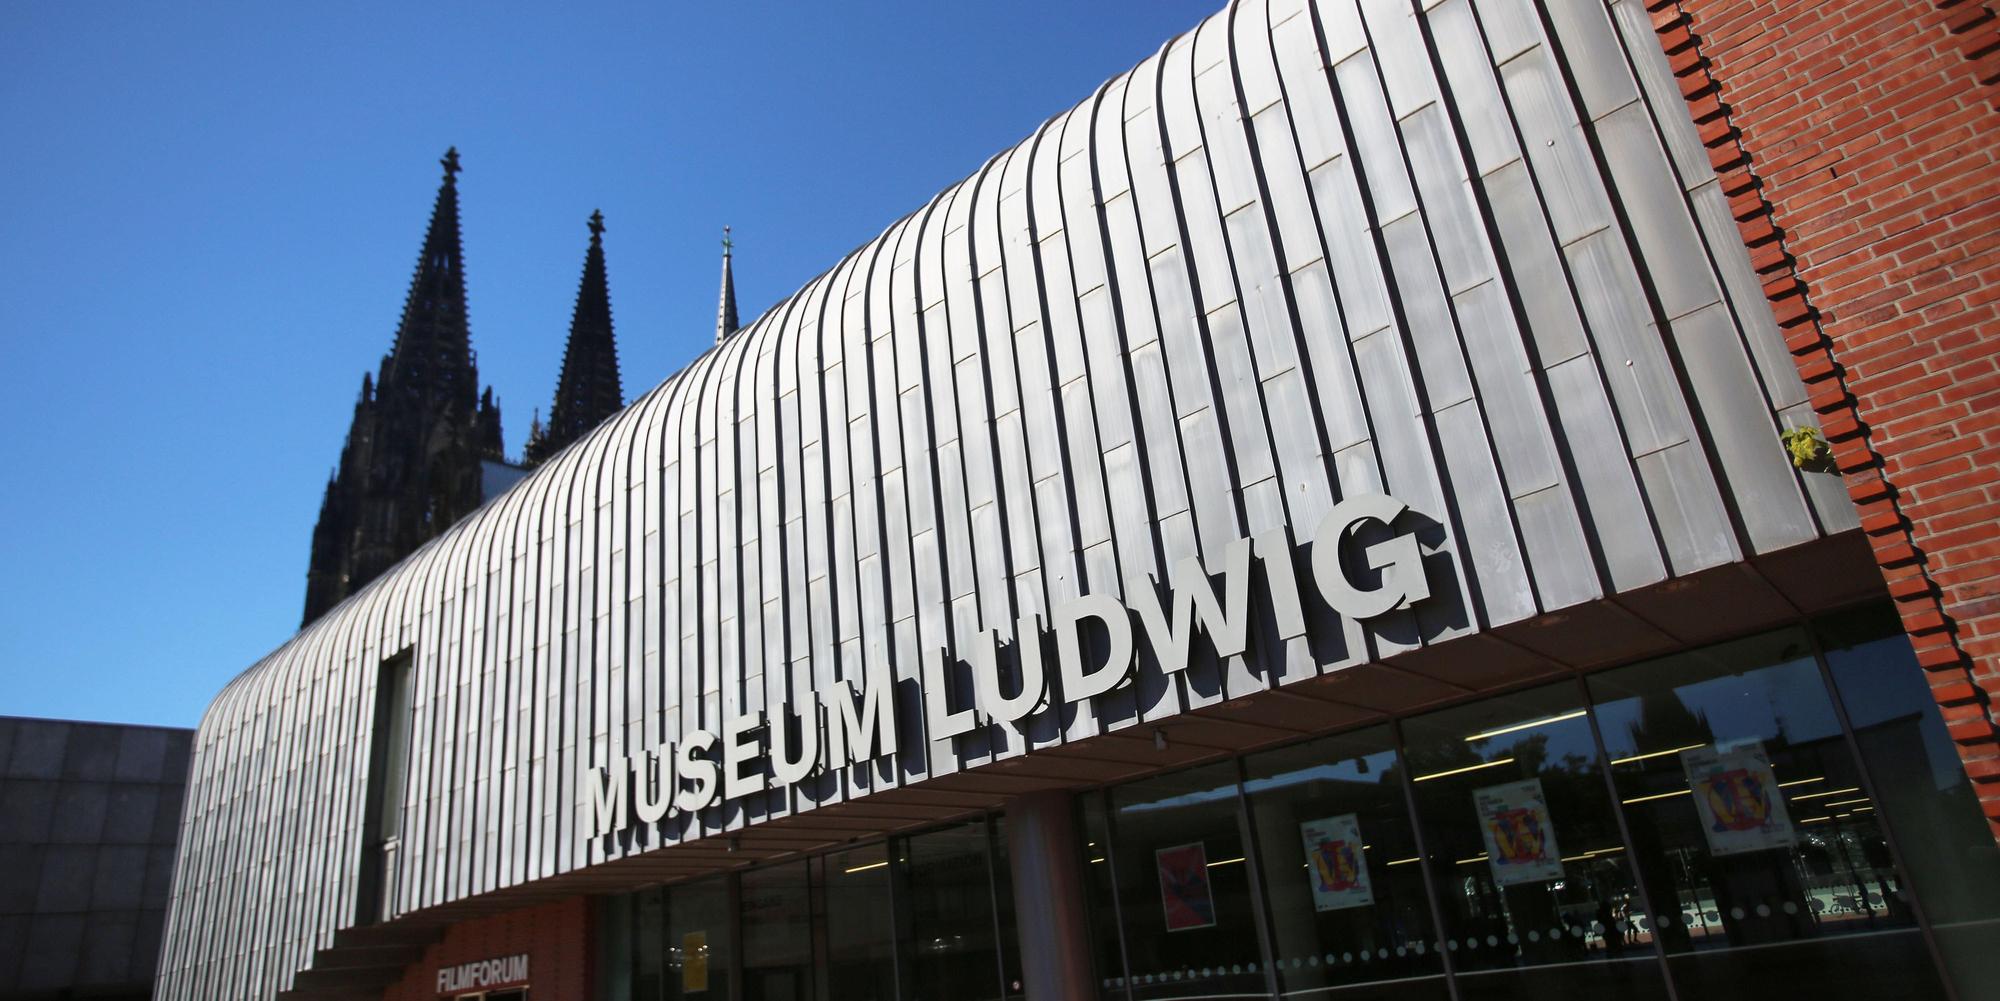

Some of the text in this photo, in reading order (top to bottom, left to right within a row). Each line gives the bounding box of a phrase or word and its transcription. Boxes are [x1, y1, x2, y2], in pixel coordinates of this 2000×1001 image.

[587, 493, 1431, 839] MUSEUM LUDWIG
[437, 954, 528, 993] FILMFORUM
